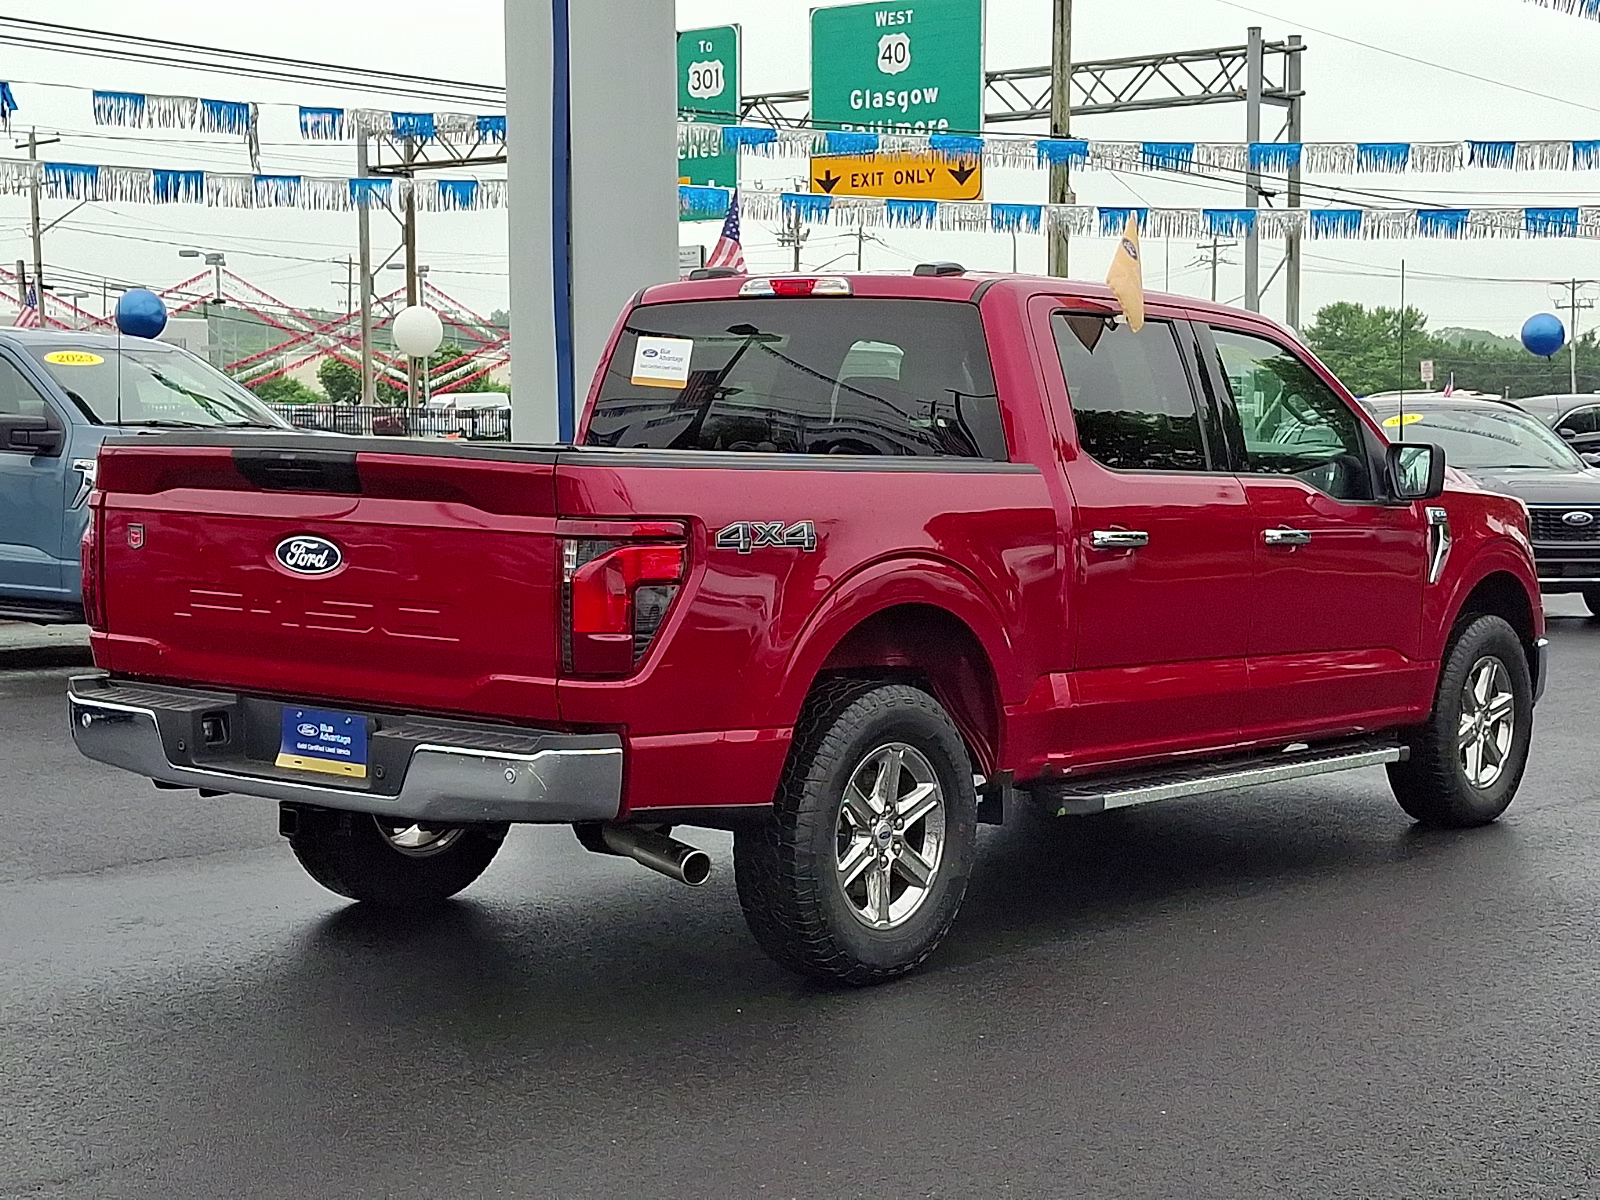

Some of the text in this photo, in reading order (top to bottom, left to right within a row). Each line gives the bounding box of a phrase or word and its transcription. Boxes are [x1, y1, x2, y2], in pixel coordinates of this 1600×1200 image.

[875, 9, 914, 27] WEST
[881, 42, 906, 65] 40
[691, 68, 719, 91] 301
[850, 87, 939, 113] Glasgow
[851, 168, 936, 188] EXIT ONLY
[56, 354, 94, 362] 2023
[286, 540, 329, 568] Ford
